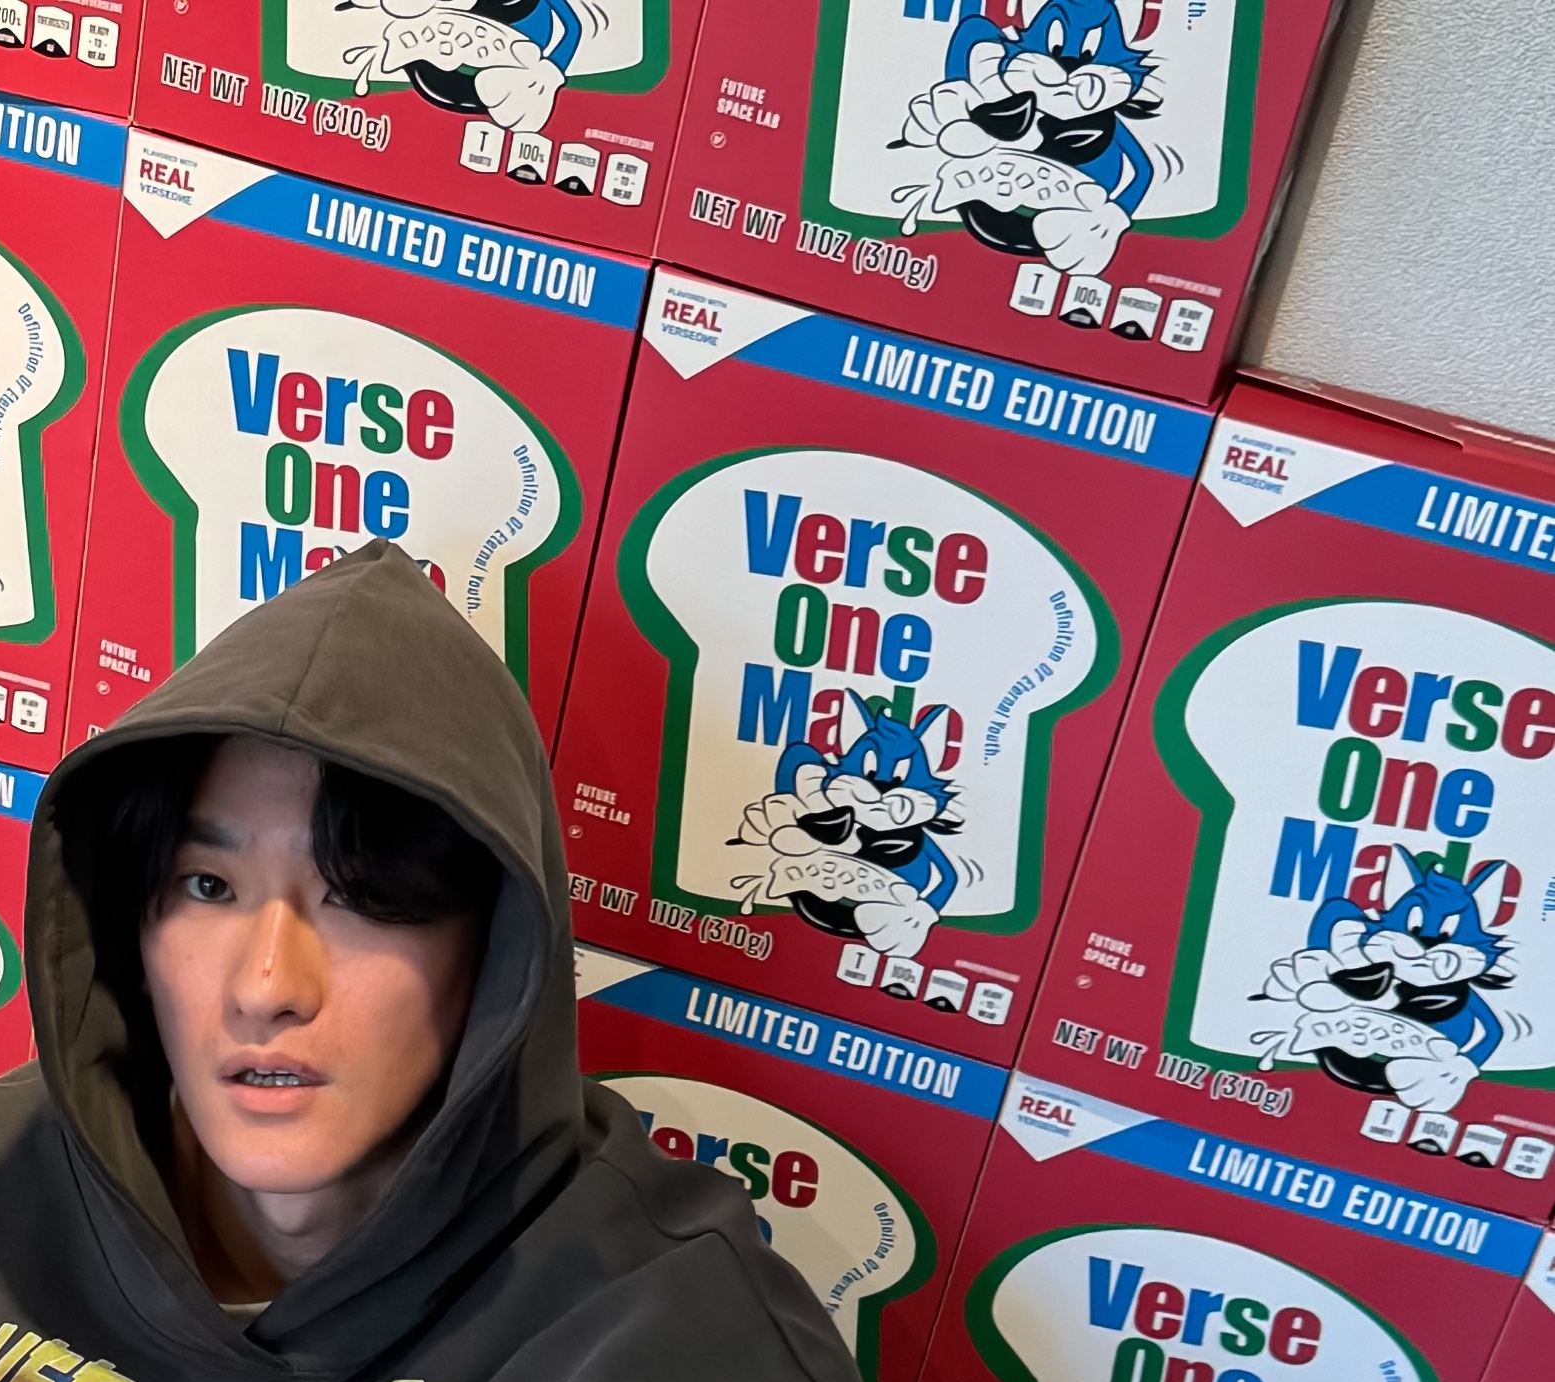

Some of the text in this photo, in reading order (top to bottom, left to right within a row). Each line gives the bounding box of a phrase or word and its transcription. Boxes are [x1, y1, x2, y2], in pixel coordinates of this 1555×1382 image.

[161, 54, 204, 92] NET
[211, 67, 248, 105] WT
[139, 157, 197, 192] REAL
[691, 188, 739, 228] NET
[743, 204, 785, 242] WT
[305, 192, 596, 308] LIMITED EDITION
[662, 297, 725, 334] REAL
[227, 348, 455, 458] Verse
[841, 332, 1156, 455] LIMITED EDITION
[266, 442, 409, 538] One
[1222, 444, 1295, 481] REAL
[747, 487, 990, 604] Verse
[1416, 485, 1555, 562] LIMITE
[775, 583, 931, 682] One
[1297, 640, 1555, 759] Verse
[1318, 736, 1494, 836] One
[569, 869, 595, 903] ET
[601, 882, 637, 915] WT
[684, 984, 961, 1100] LIMITED EDITION
[1053, 1020, 1101, 1053] NET
[1105, 1035, 1147, 1068] WT
[1018, 1093, 1080, 1126] REAL
[640, 1112, 819, 1208] erse
[1187, 1136, 1490, 1256] LIMITED EDITION
[1090, 1256, 1325, 1365] Verse
